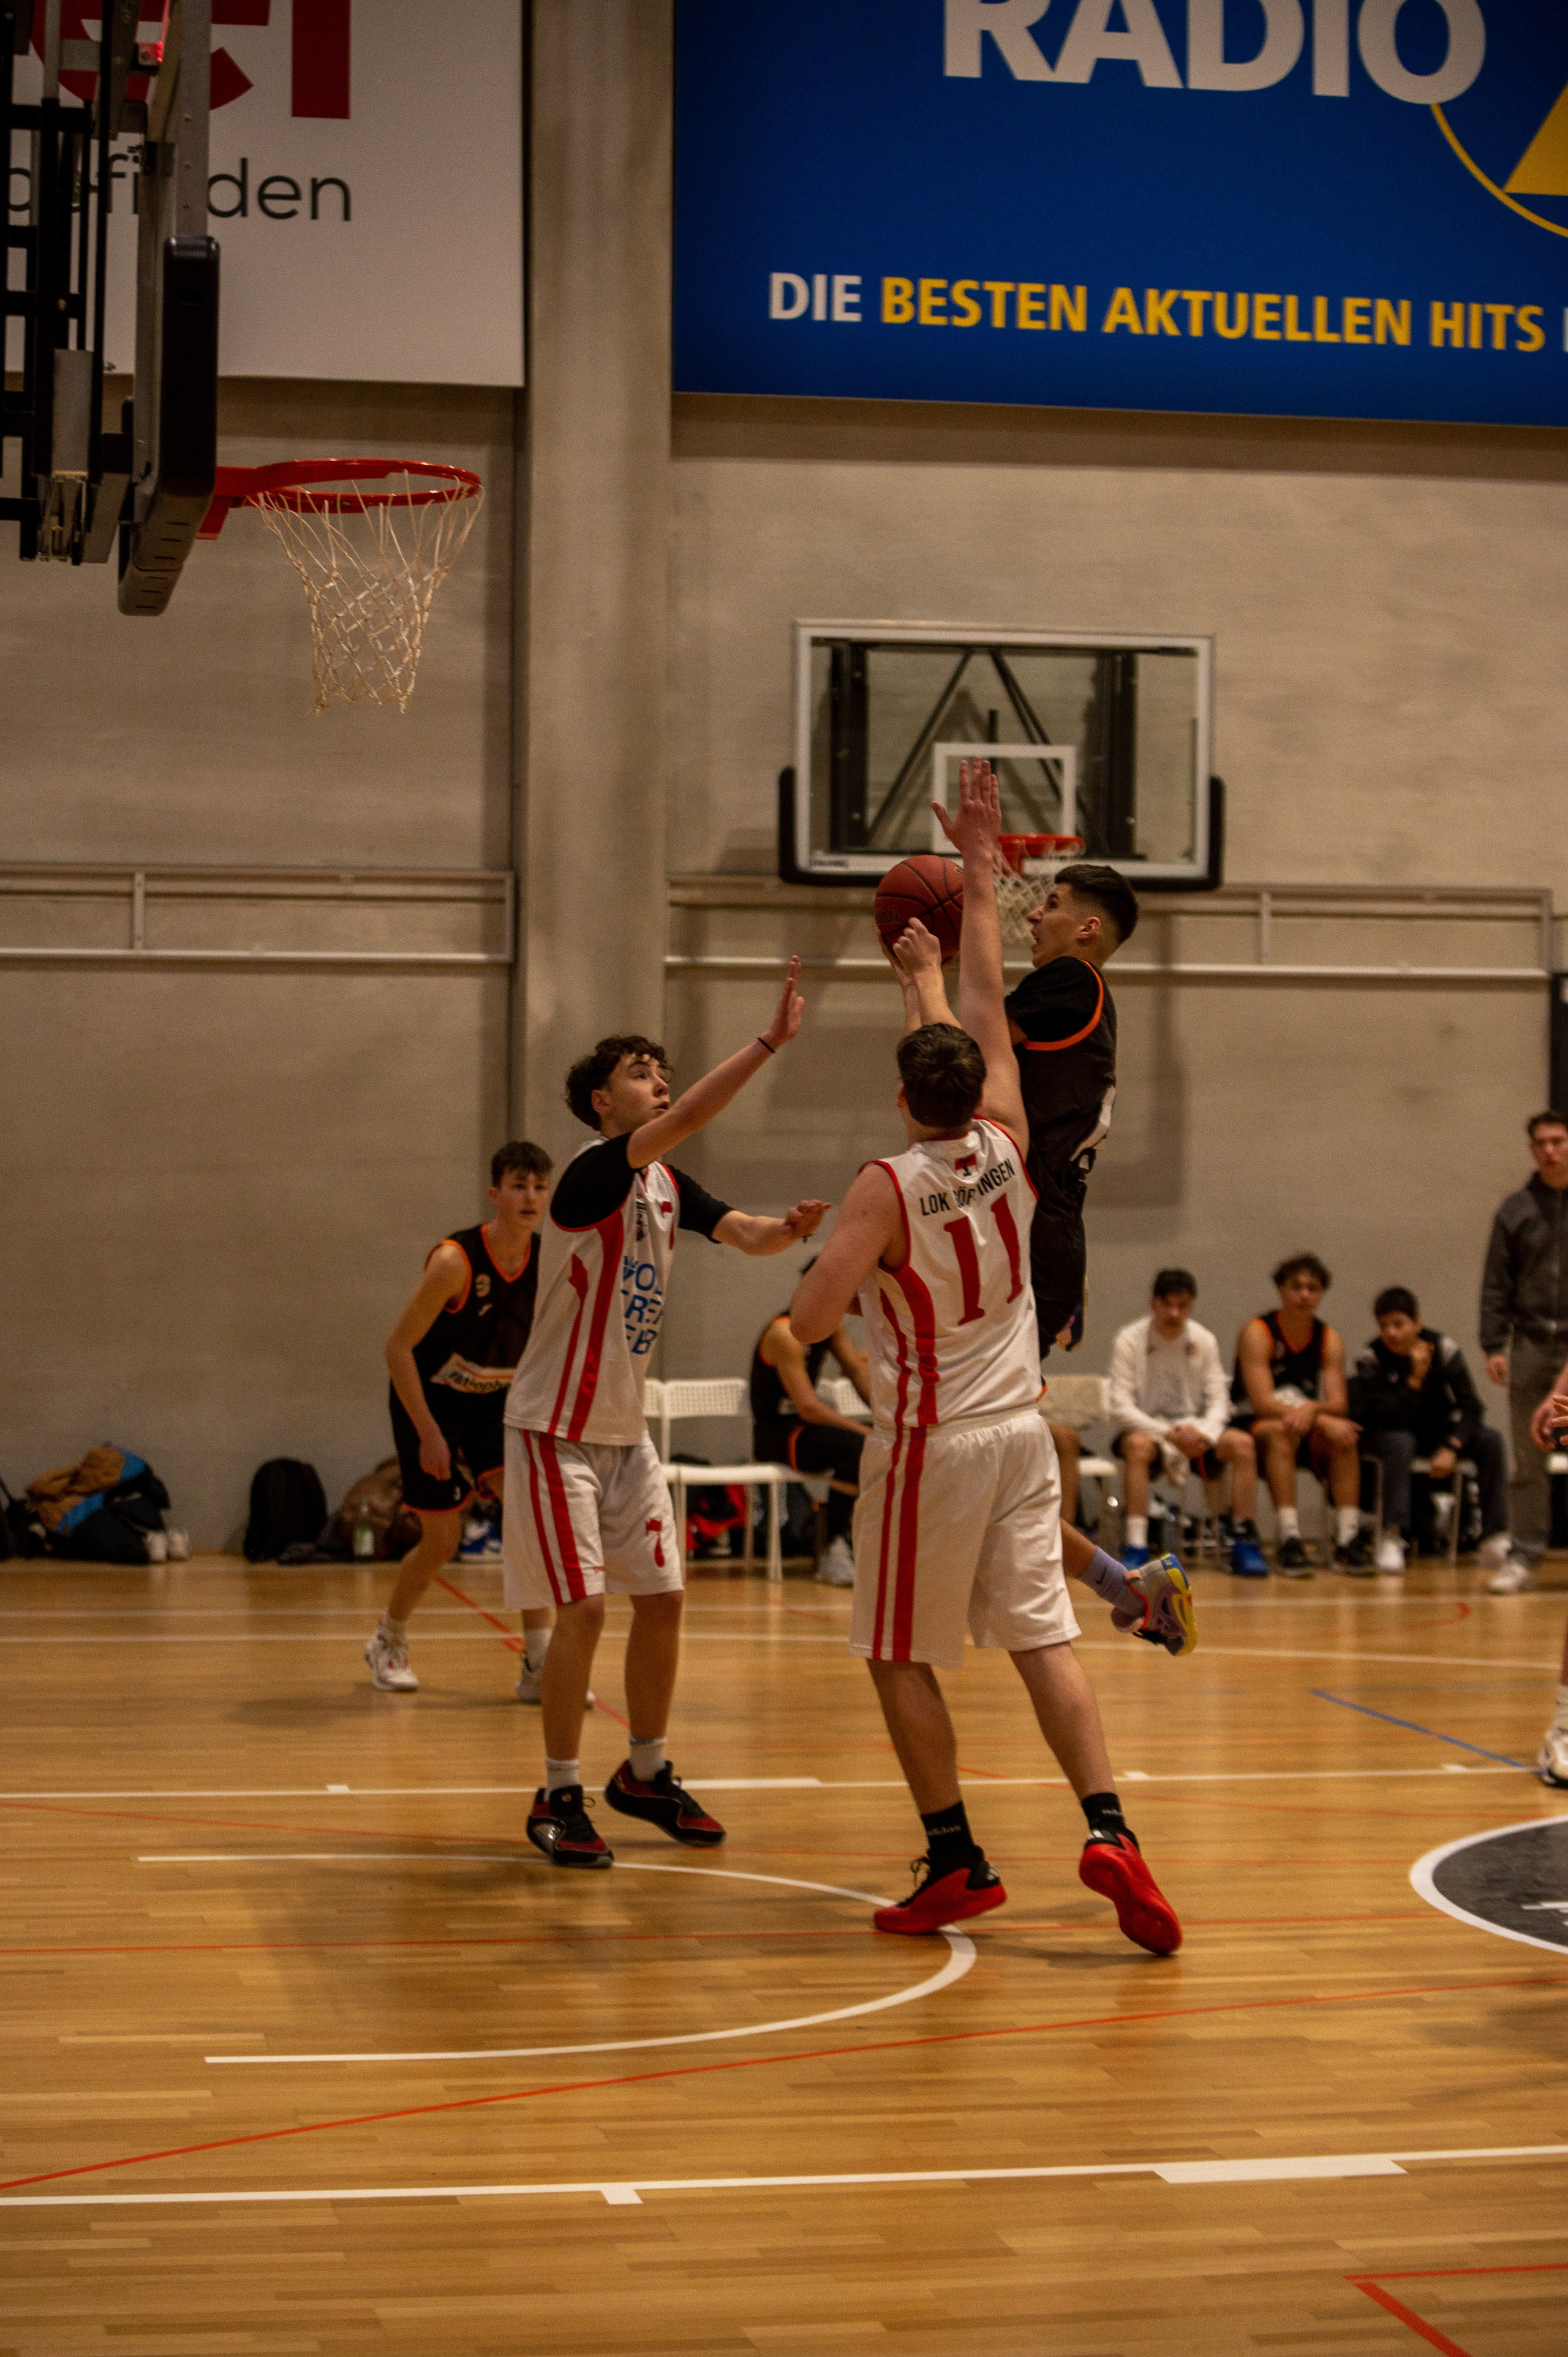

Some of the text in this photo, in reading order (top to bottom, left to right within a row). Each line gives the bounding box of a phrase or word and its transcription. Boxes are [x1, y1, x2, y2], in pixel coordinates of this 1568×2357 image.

[943, 0, 1486, 105] RADIO
[769, 272, 862, 322] DIE
[881, 276, 1088, 332] BESTEN
[1101, 286, 1412, 346] AKTUELLEN
[1429, 300, 1546, 352] HITS
[920, 1192, 951, 1216] LOK
[943, 1193, 1023, 1326] 11
